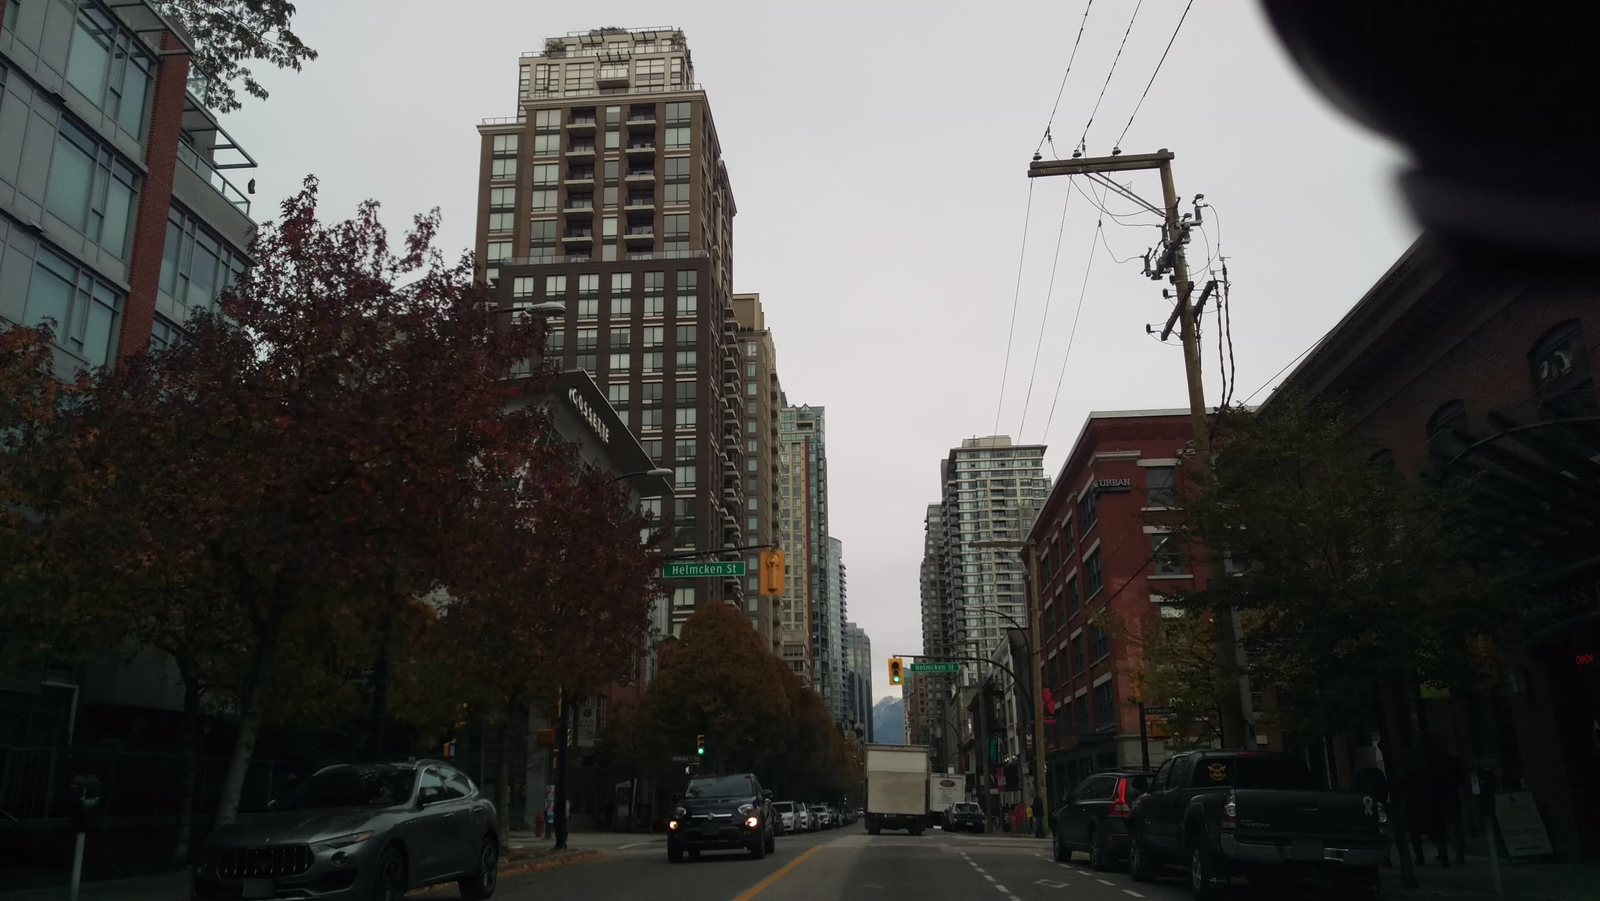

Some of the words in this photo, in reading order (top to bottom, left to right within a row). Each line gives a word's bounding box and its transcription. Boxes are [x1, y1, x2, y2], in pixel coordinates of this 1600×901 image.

[568, 388, 609, 443] COSSETTE
[1100, 479, 1130, 487] URBAN
[672, 564, 722, 575] Helmcken
[726, 563, 737, 574] St
